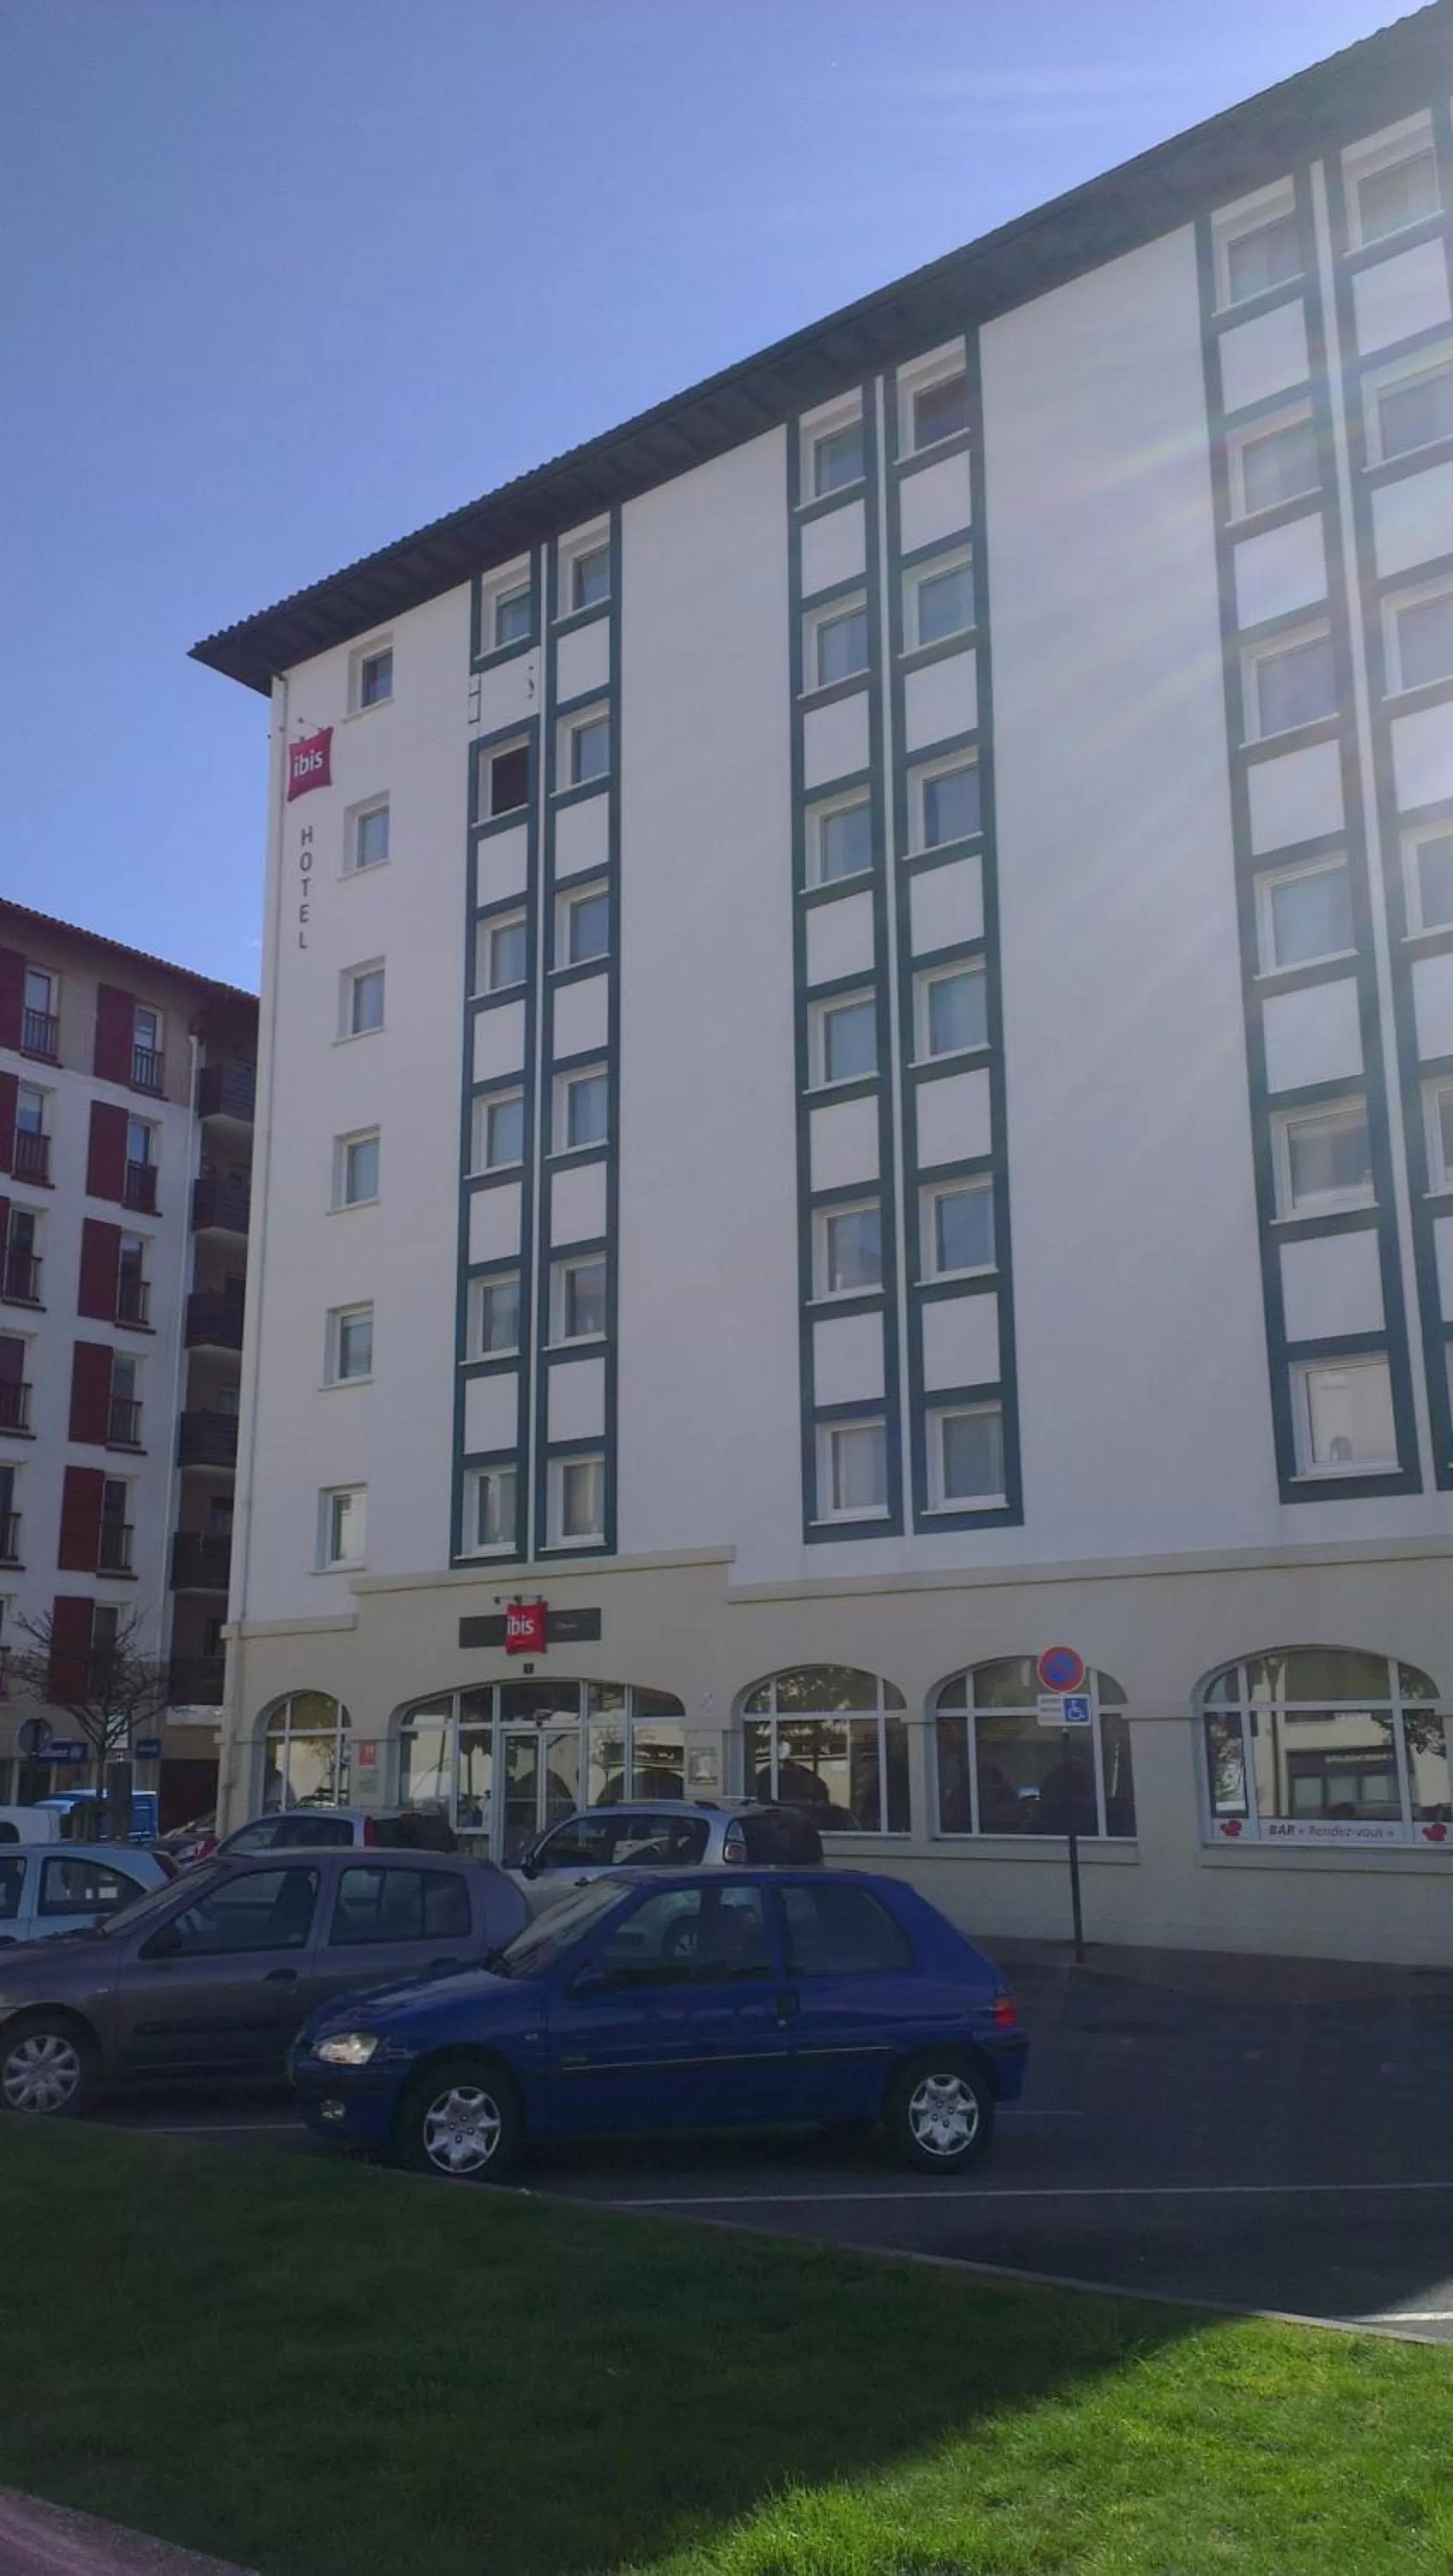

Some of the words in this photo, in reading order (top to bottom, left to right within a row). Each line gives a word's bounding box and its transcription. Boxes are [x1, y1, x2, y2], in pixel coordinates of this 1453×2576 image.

[294, 749, 324, 778] ibis
[298, 825, 313, 950] HOTEL
[507, 1614, 536, 1636] ibis
[1268, 1825, 1295, 1836] BAR
